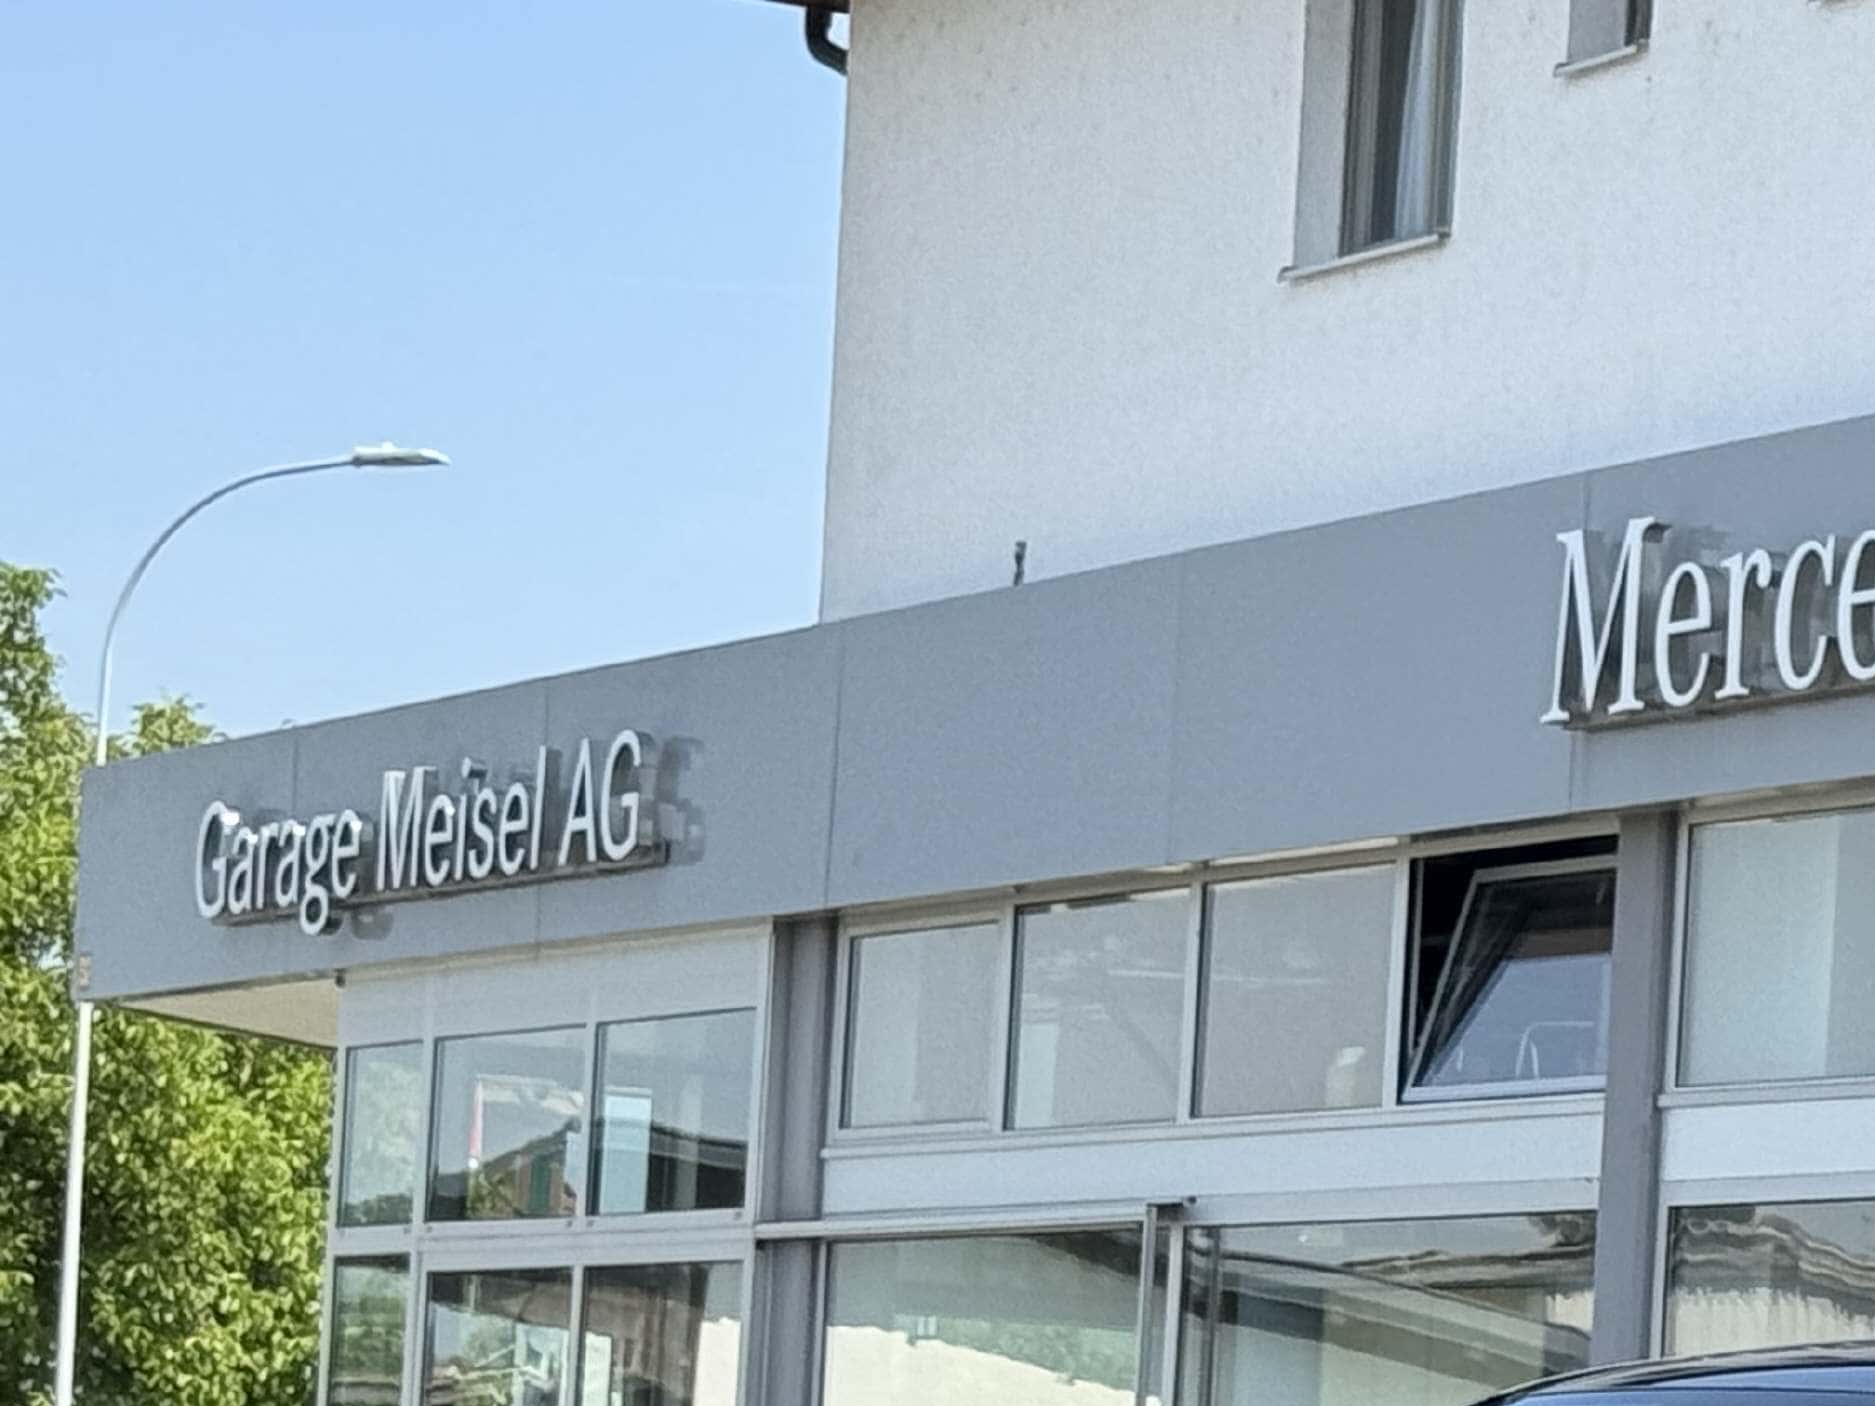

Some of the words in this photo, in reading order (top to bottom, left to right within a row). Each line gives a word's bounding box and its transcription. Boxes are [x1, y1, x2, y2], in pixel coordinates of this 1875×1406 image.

[195, 800, 361, 935] Garage
[376, 745, 547, 891] Meisel
[559, 729, 643, 866] AG
